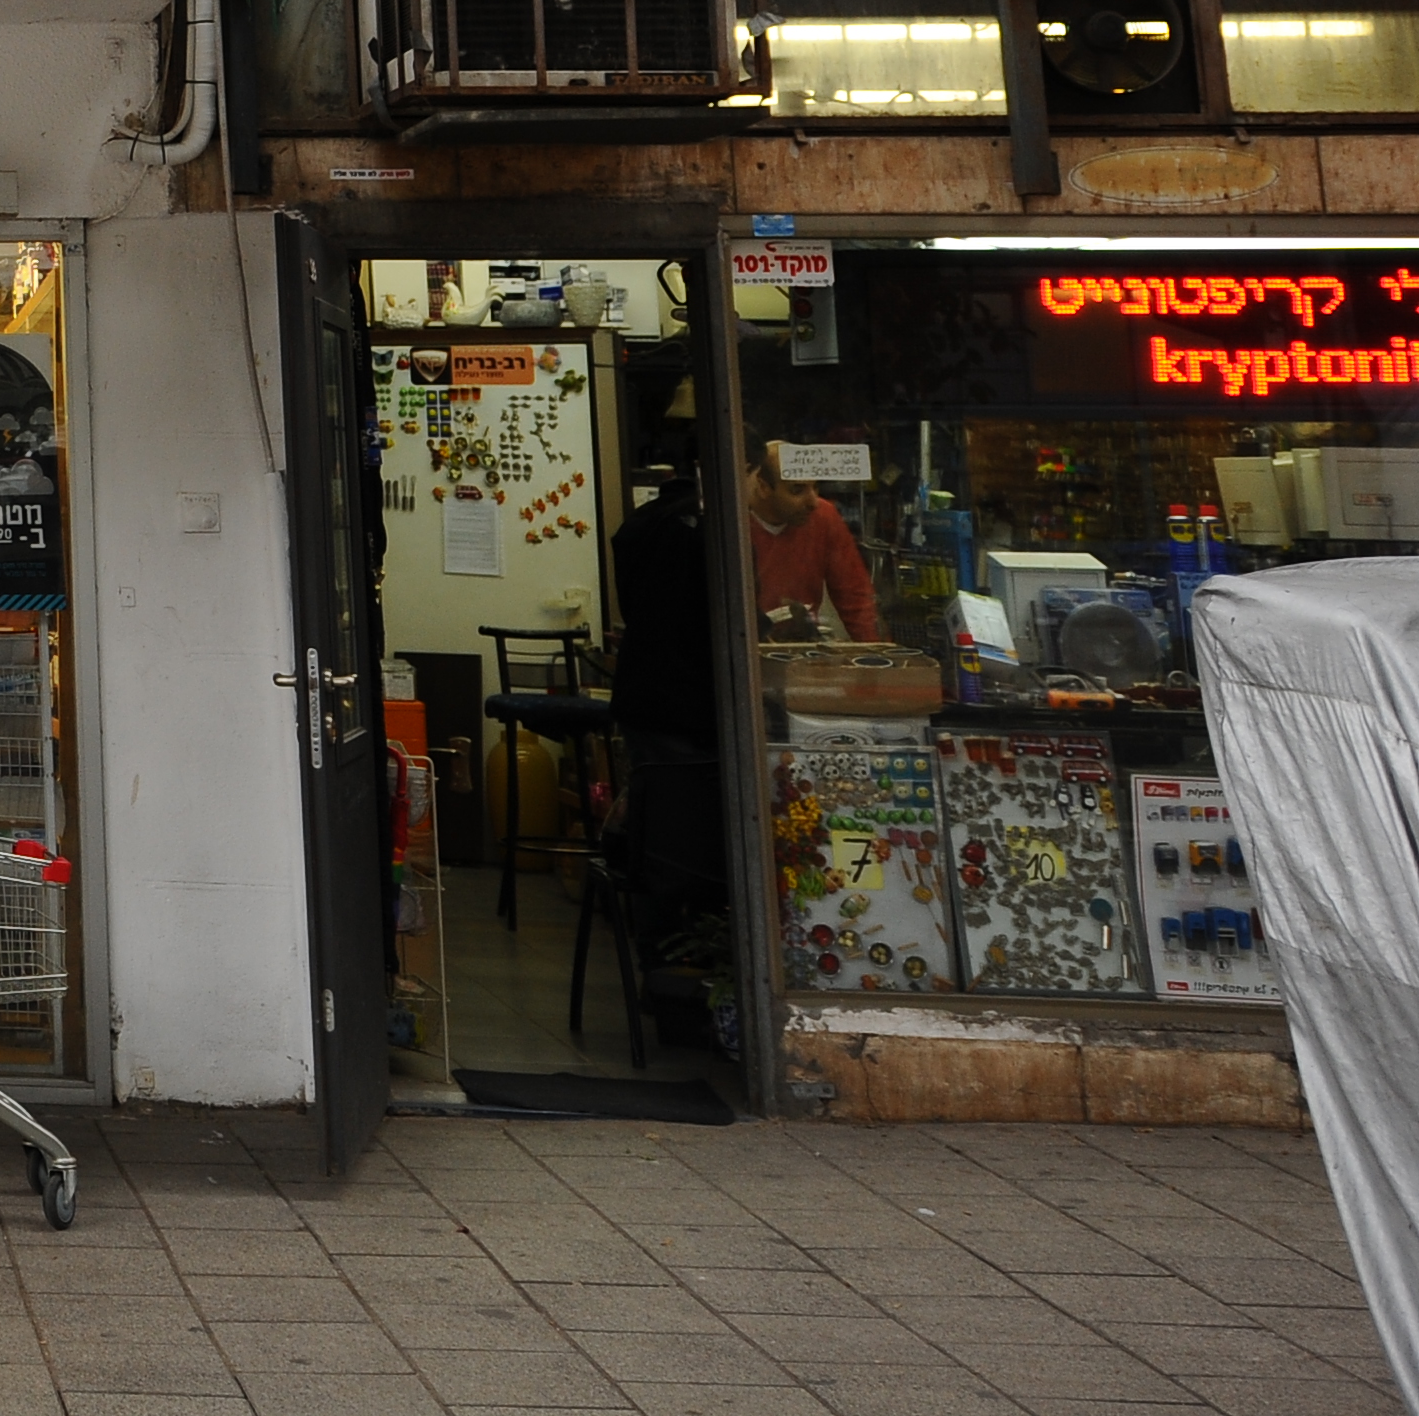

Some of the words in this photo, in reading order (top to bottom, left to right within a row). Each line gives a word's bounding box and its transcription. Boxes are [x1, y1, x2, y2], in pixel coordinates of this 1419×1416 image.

[733, 254, 828, 277] מוקד-101
[1040, 276, 1205, 327] קריפטונייט
[454, 356, 526, 370] רב-בריח
[843, 838, 872, 883] 7
[1025, 853, 1055, 882] 10
